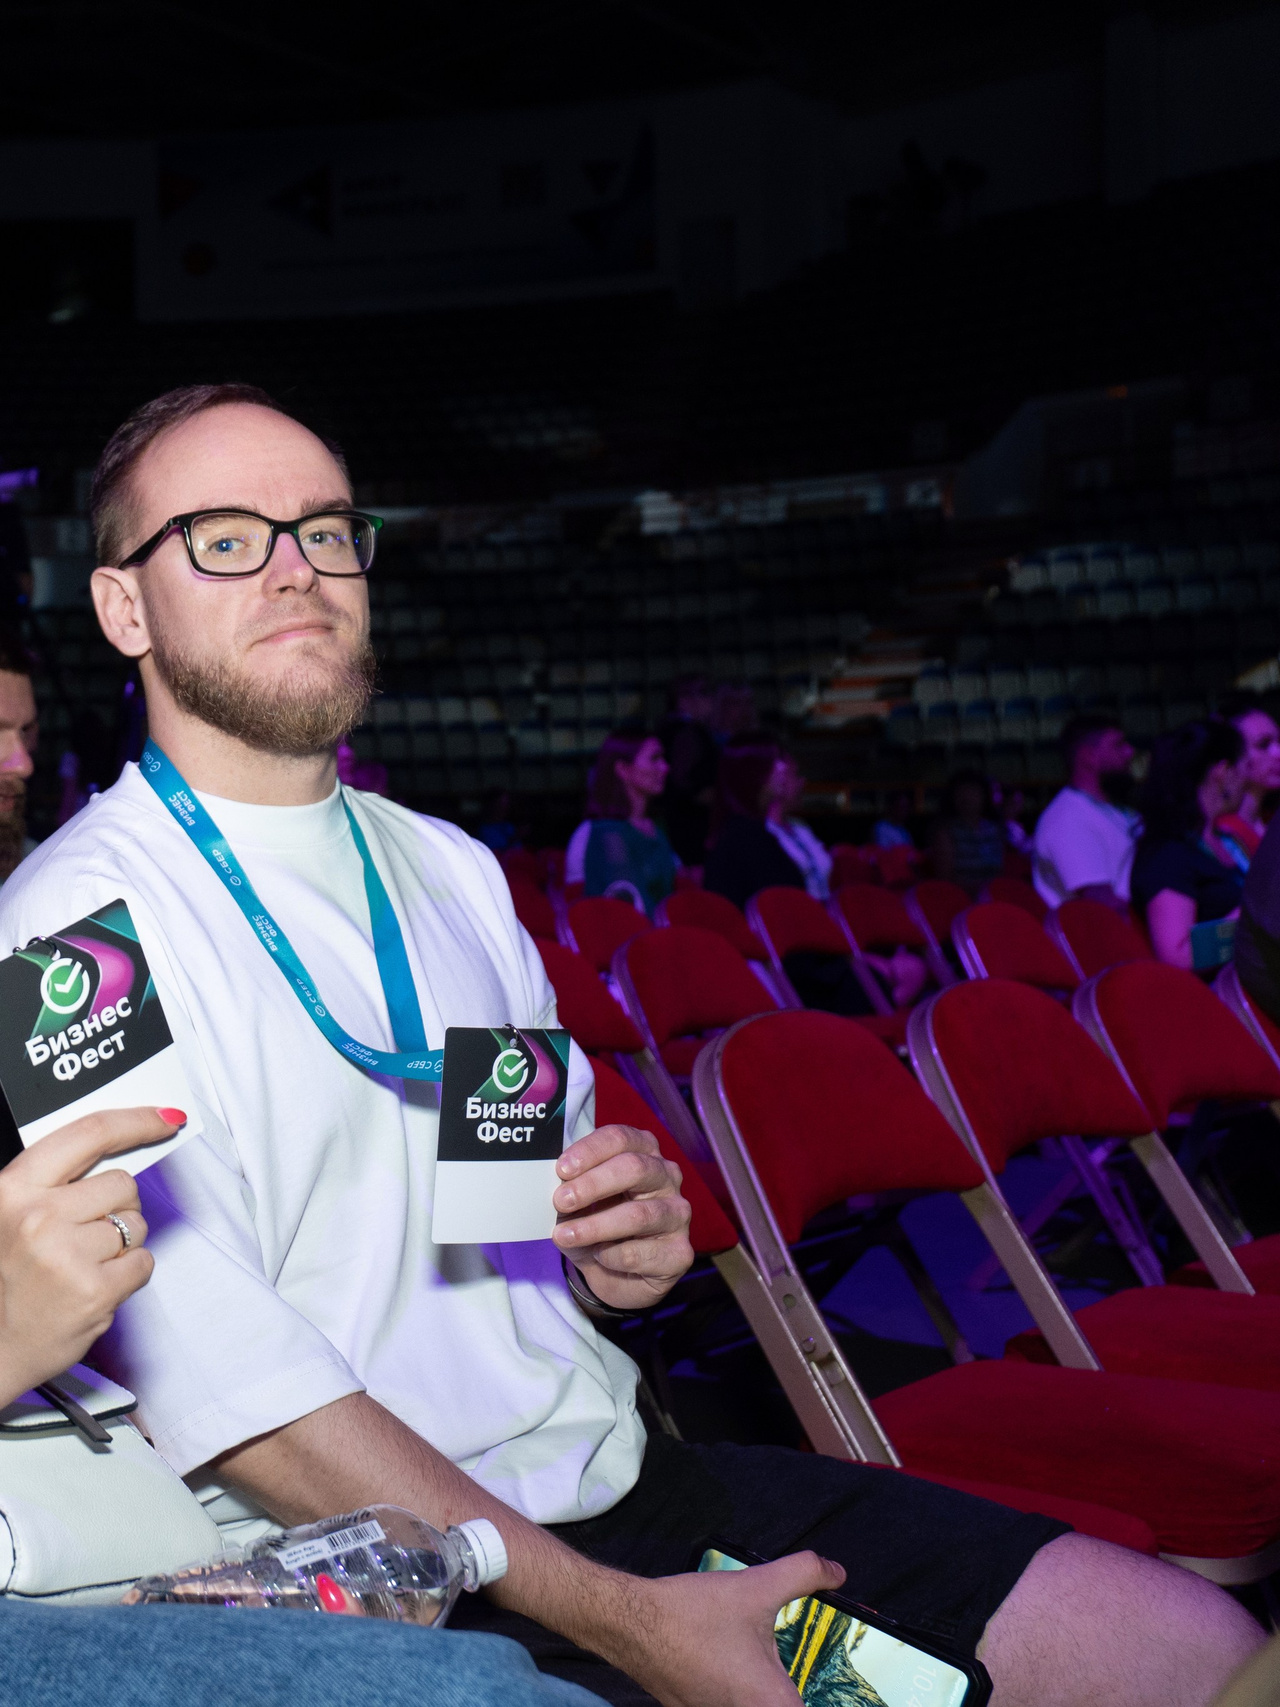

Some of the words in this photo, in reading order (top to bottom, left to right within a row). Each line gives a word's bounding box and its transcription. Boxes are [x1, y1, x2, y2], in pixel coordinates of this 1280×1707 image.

[167, 794, 196, 827] БИЗНЕС
[176, 790, 196, 813] ФЕСТ
[212, 849, 232, 875] СБЕР
[252, 915, 278, 952] БИЗНЕС
[259, 914, 277, 937] ФЕСТ
[24, 996, 133, 1067] Бизнес
[52, 1030, 126, 1081] Фест
[341, 1043, 379, 1066] БИЗНЕС
[347, 1042, 373, 1057] ФЕСТ
[406, 1060, 433, 1070] СБЕР
[466, 1096, 547, 1120] Бизнес
[477, 1120, 535, 1144] Фест
